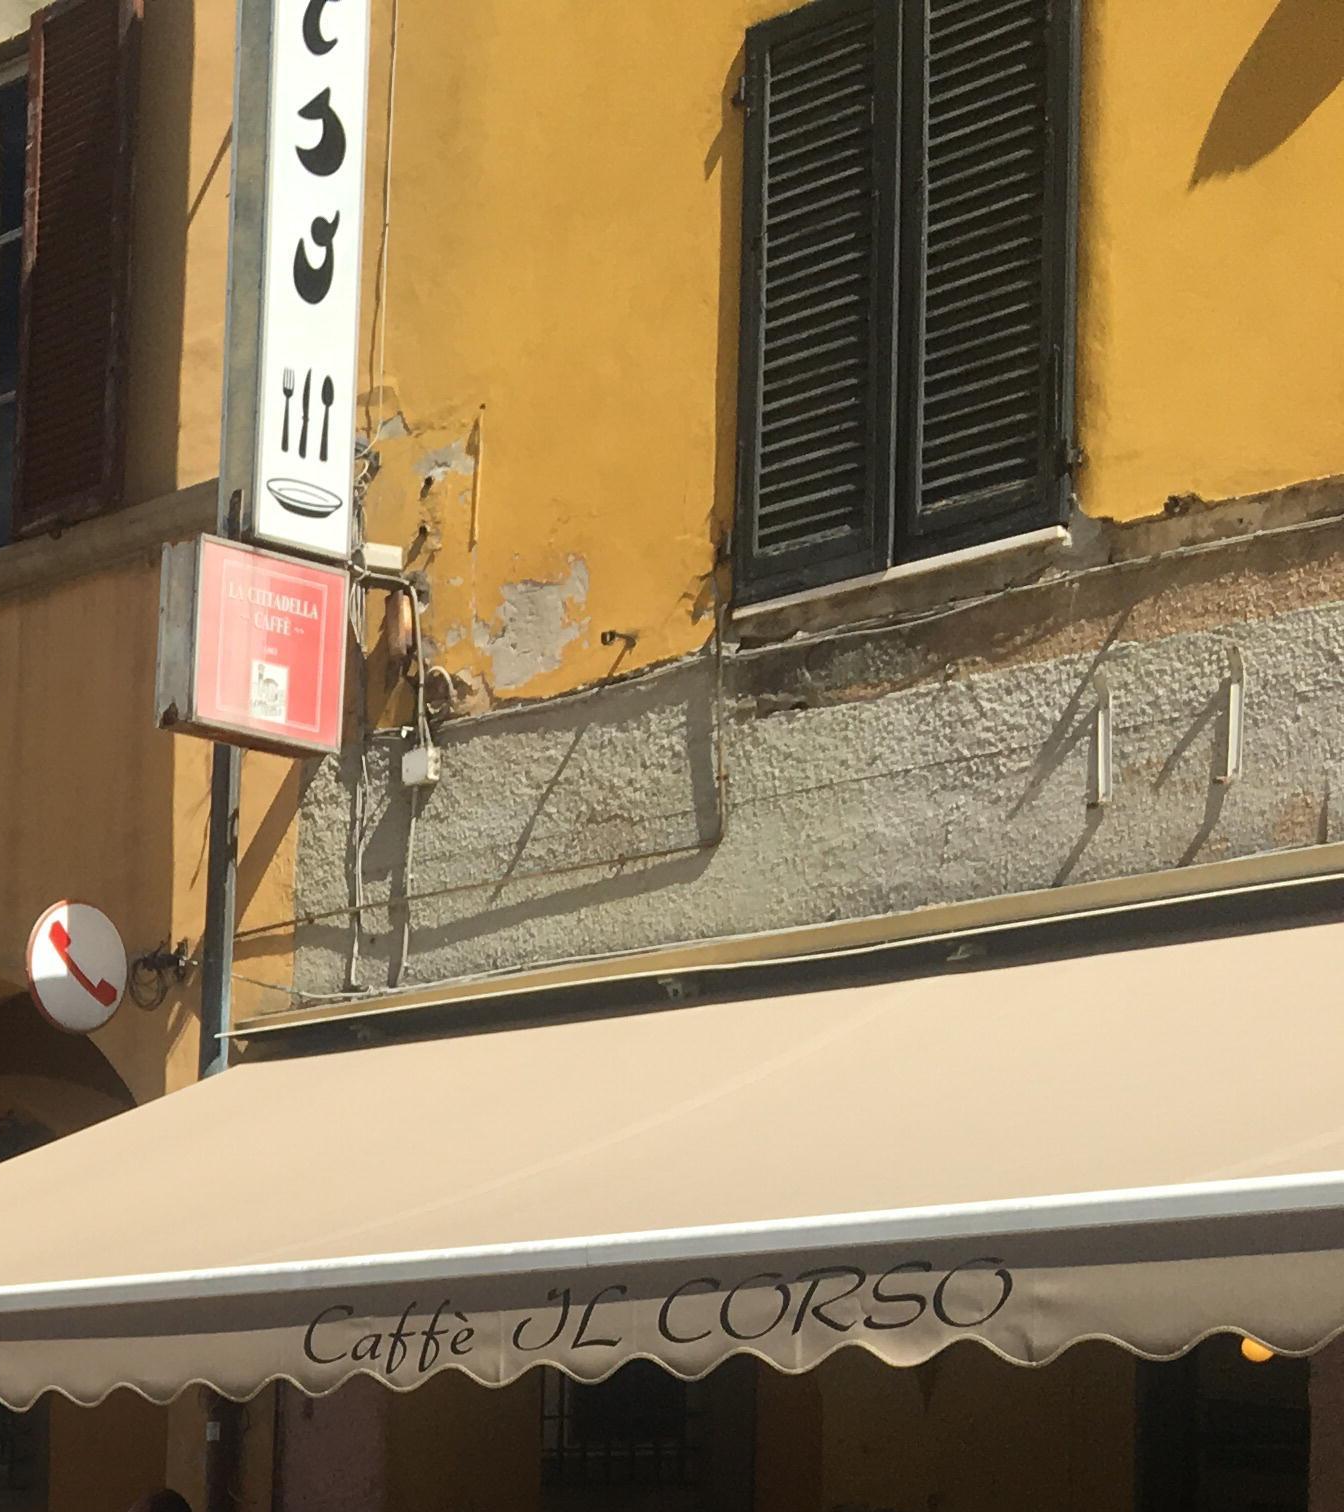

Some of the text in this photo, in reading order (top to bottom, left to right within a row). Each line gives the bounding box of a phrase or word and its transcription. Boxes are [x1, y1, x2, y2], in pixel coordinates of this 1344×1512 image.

[229, 581, 319, 620] LA CITTADELLA
[303, 1302, 475, 1374] Caffè
[657, 1257, 1012, 1344] CORSO
